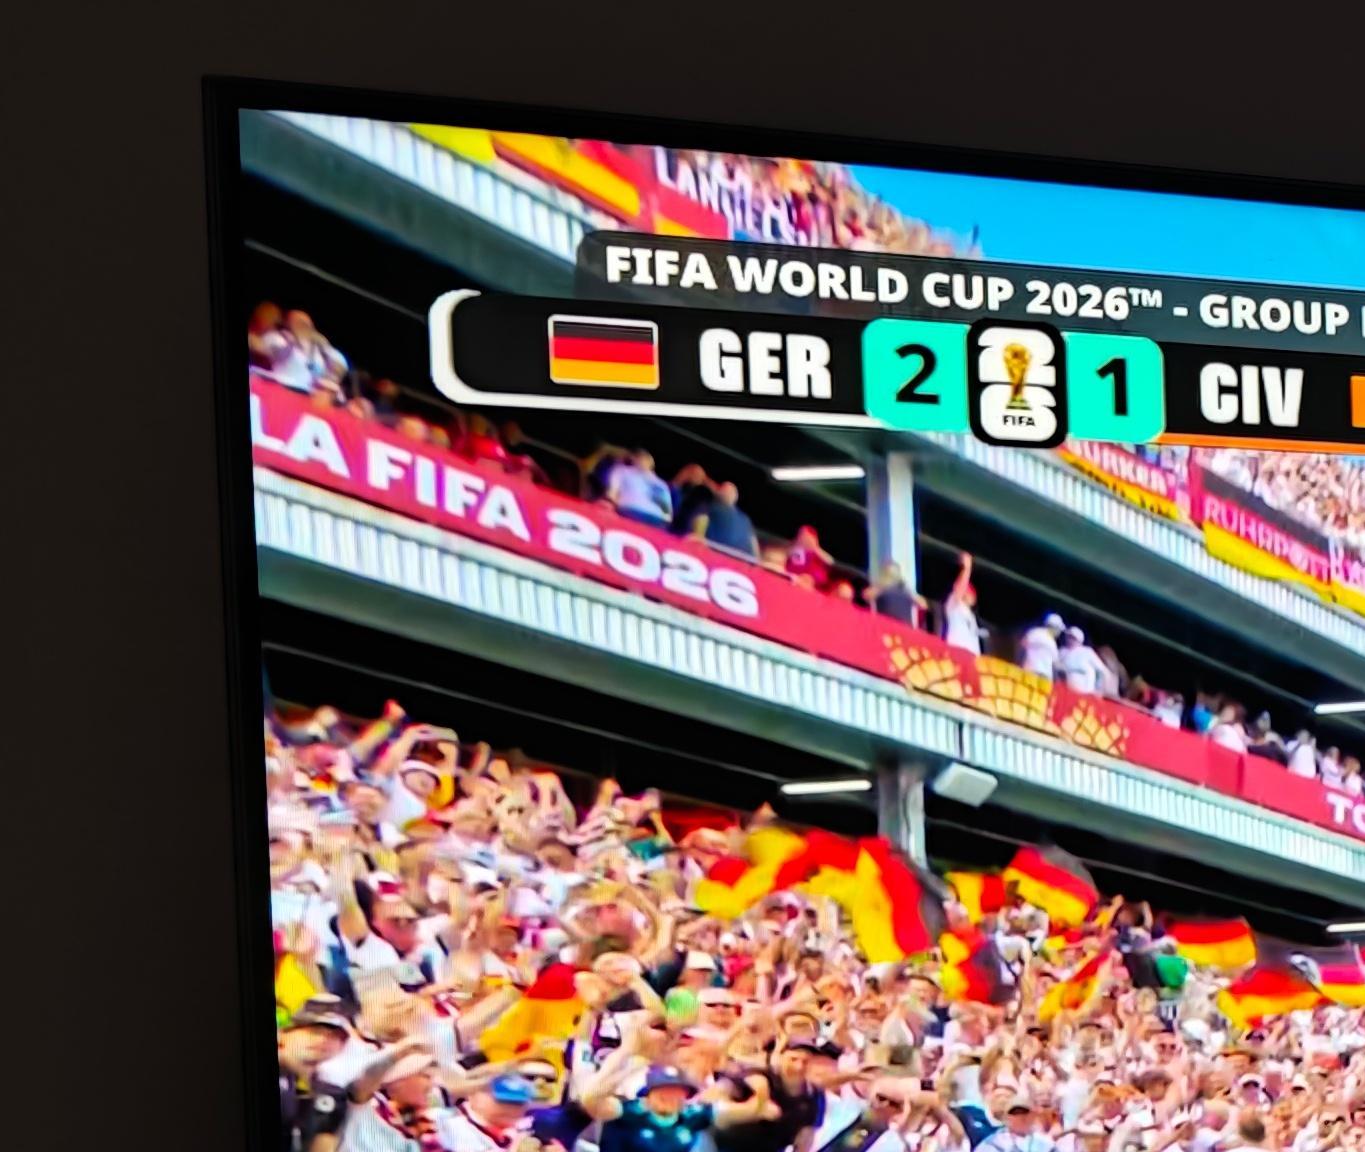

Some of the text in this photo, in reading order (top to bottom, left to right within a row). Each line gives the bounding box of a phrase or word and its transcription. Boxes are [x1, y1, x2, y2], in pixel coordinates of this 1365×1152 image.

[606, 245, 717, 290] FIFA
[727, 255, 908, 303] WORLD
[922, 272, 1014, 312] CUP
[1026, 280, 1162, 320] 2026™
[1200, 293, 1350, 335] GROUP
[699, 327, 832, 399] GER
[895, 343, 939, 405] 2
[1096, 358, 1127, 416] 1
[1200, 362, 1304, 427] CIV
[1003, 414, 1036, 428] FIFA
[366, 440, 531, 542] FIFA
[547, 509, 760, 618] 2026
